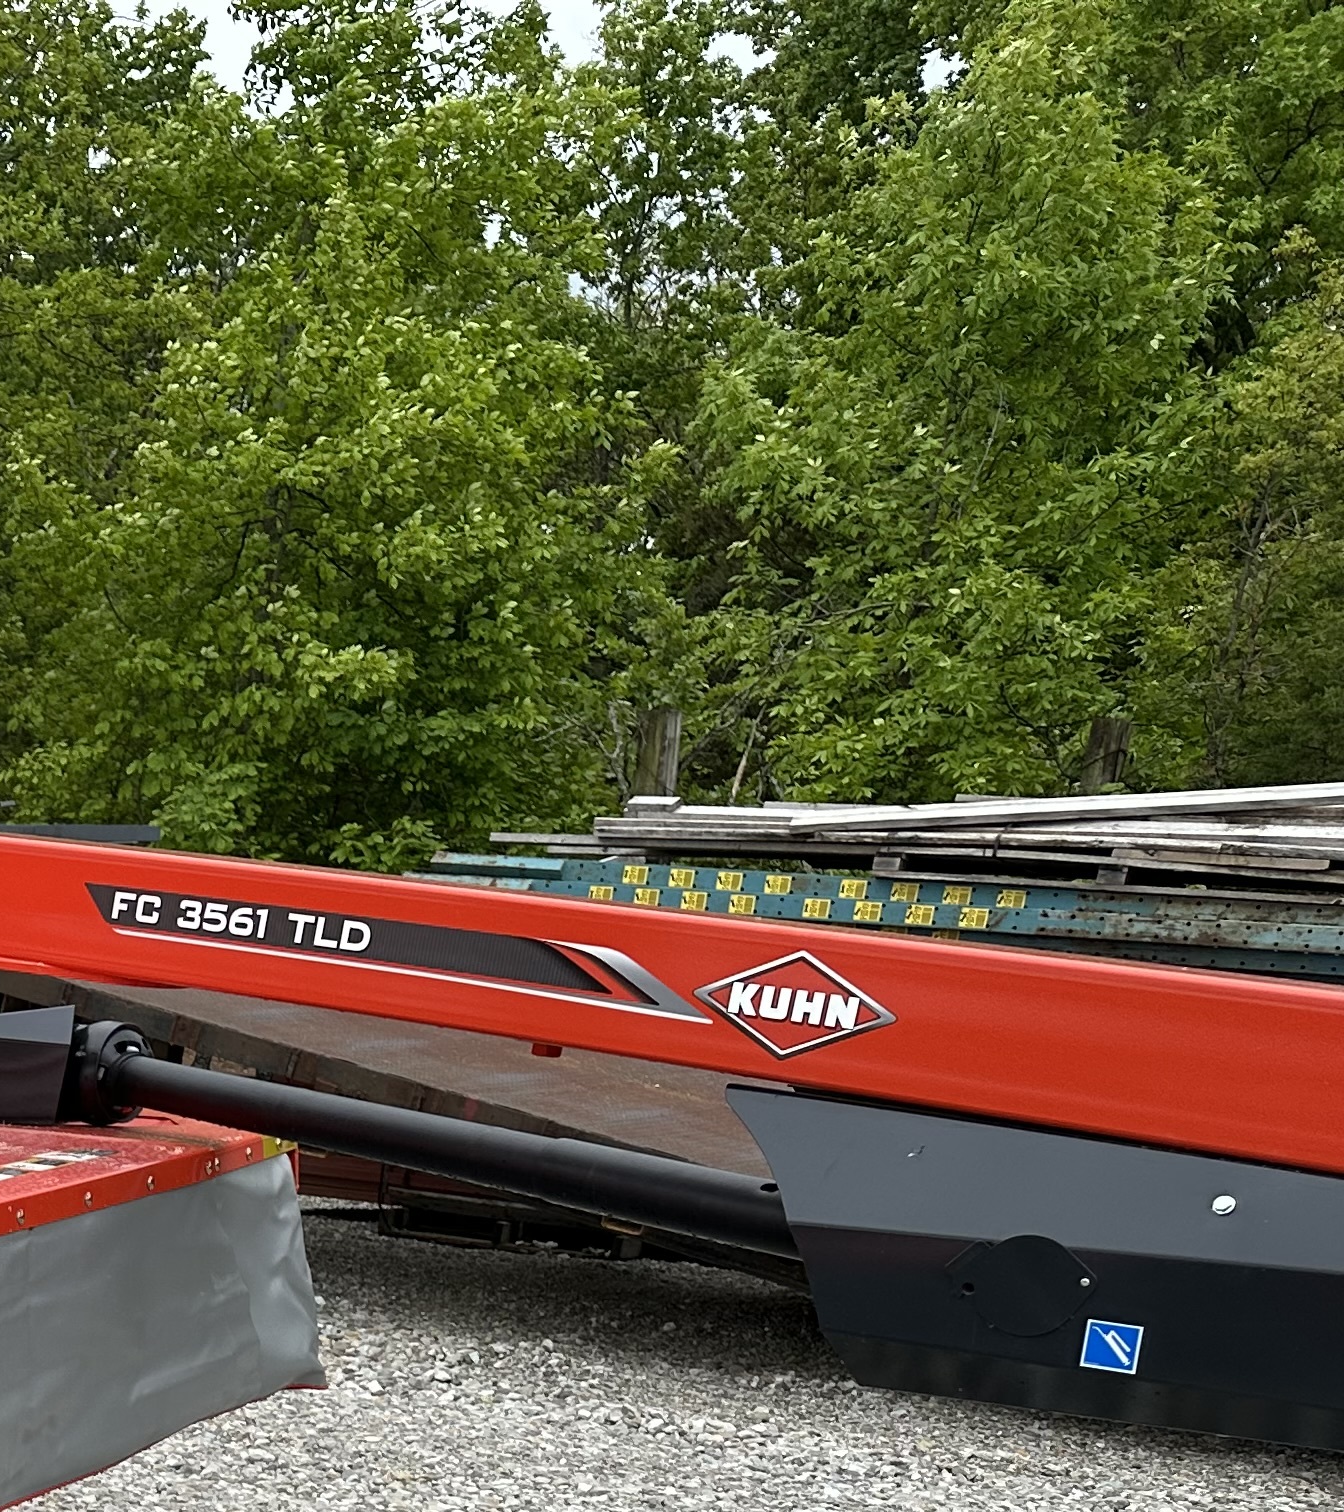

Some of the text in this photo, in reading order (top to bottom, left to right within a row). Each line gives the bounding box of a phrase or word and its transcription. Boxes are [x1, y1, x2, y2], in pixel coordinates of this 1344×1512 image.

[111, 891, 372, 952] FC 3561 TLD
[727, 981, 861, 1030] KUHN
